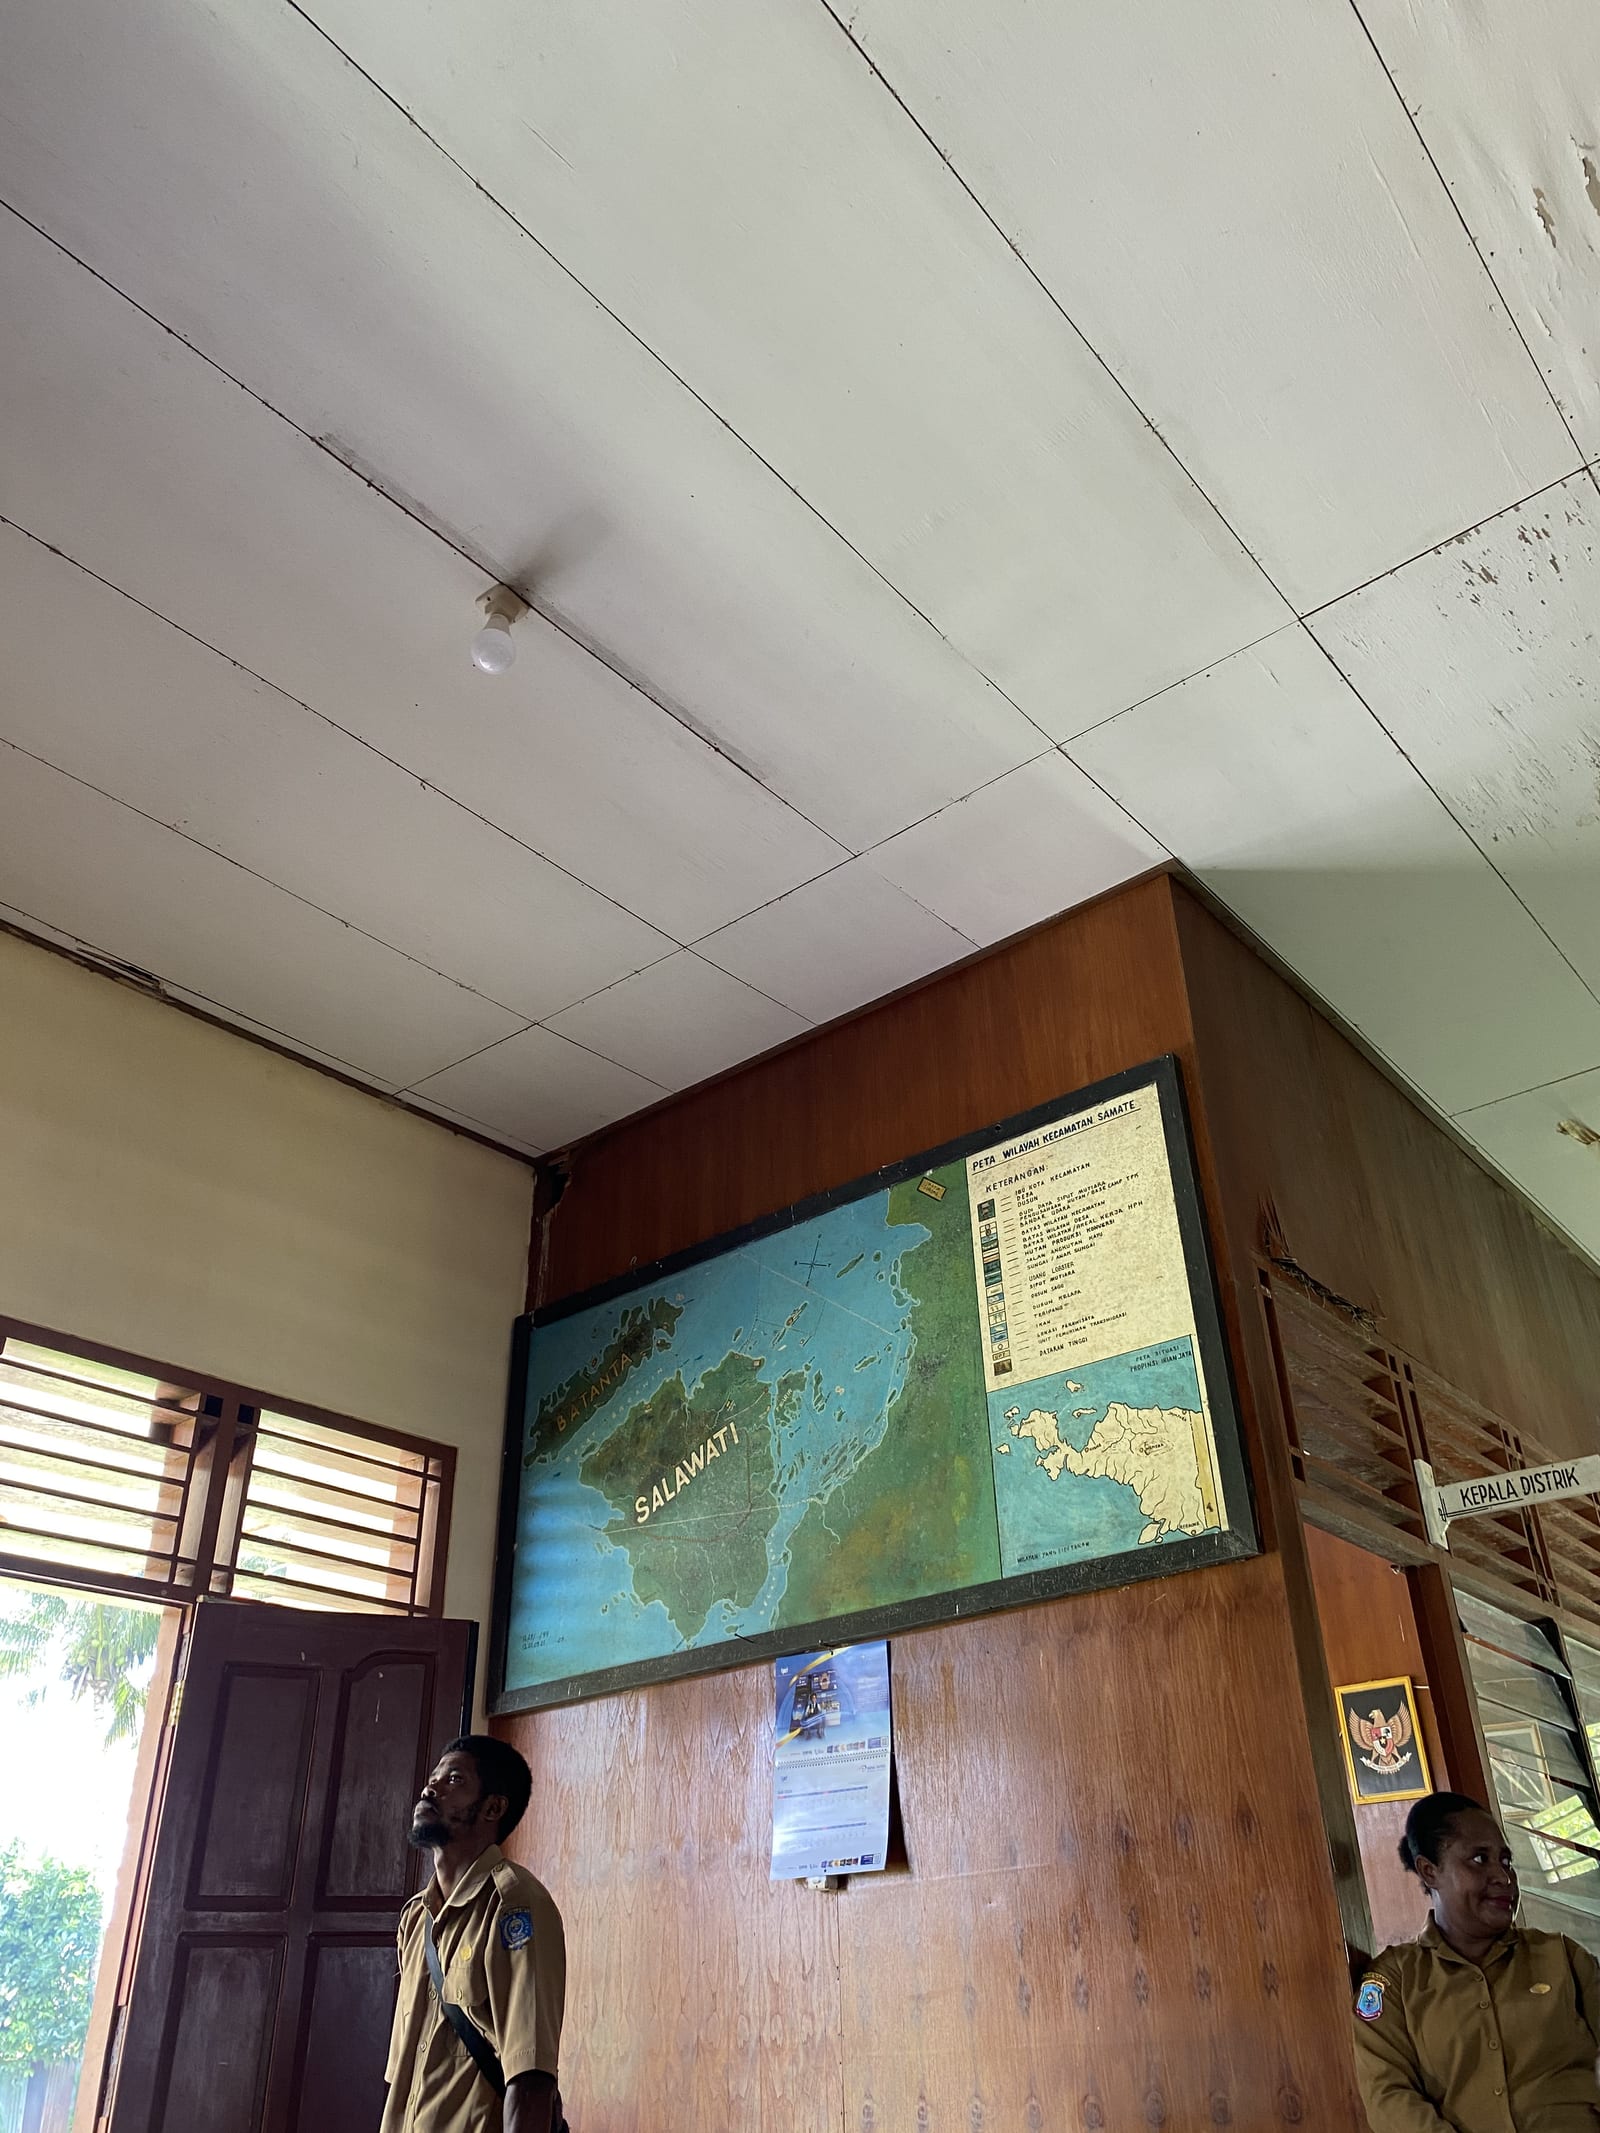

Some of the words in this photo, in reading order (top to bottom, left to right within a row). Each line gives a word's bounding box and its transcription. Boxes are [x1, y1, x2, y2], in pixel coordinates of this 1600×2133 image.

[972, 1155, 996, 1171] PETA
[1002, 1138, 1040, 1159] WILAYAH
[1042, 1117, 1093, 1143] KECAMATAN
[1097, 1100, 1135, 1121] SAMATE
[1049, 1163, 1090, 1182] KECAMATAN
[1016, 1196, 1038, 1208] DUSUN
[1024, 1244, 1047, 1256] HUTAN
[555, 1352, 632, 1432] BATANTA
[635, 1421, 739, 1523] SALAWATI
[1460, 1479, 1518, 1507] KEPALA
[1519, 1467, 1580, 1496] DISTRIK
